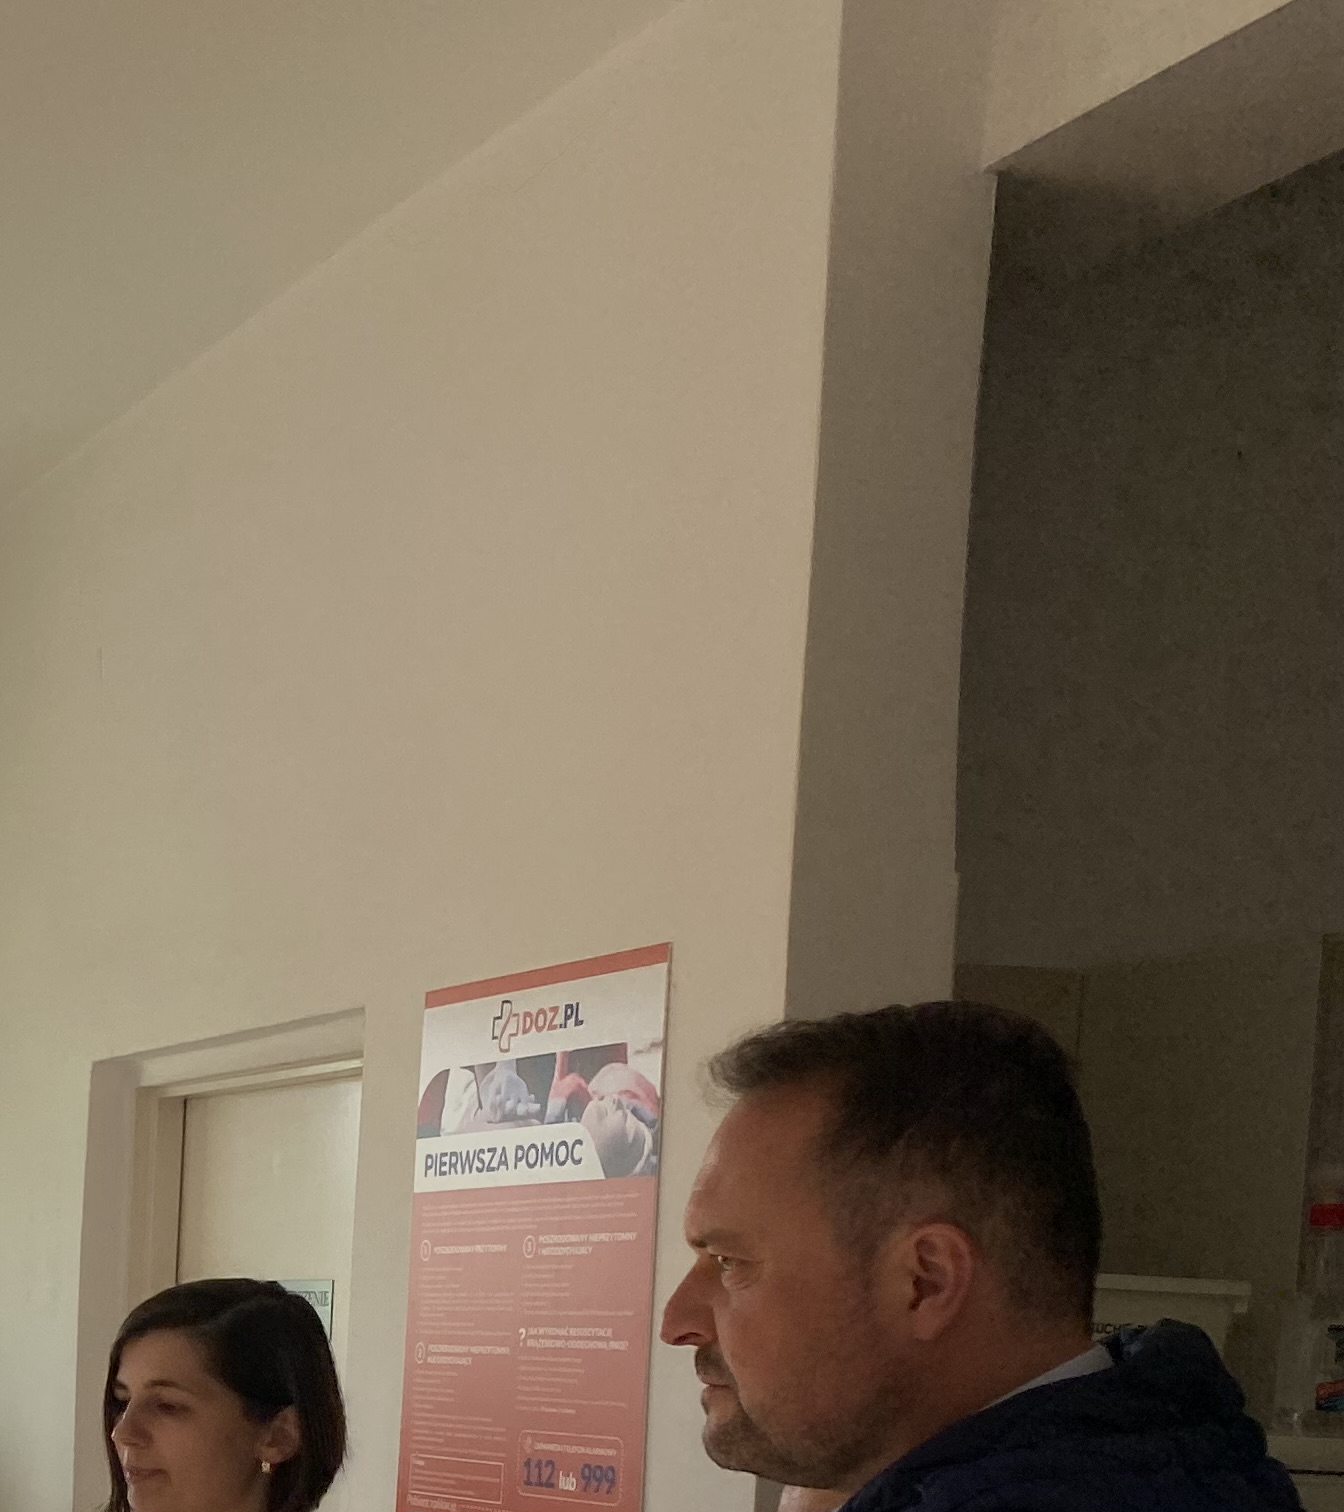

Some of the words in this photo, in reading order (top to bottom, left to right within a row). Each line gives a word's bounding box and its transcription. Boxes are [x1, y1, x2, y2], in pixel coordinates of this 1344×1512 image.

[521, 1002, 584, 1035] DOZ.PL
[424, 1146, 509, 1177] PIERWSZA
[514, 1139, 583, 1170] POMOC
[523, 1457, 556, 1489] 112
[558, 1471, 577, 1492] lub
[580, 1463, 616, 1495] 999
